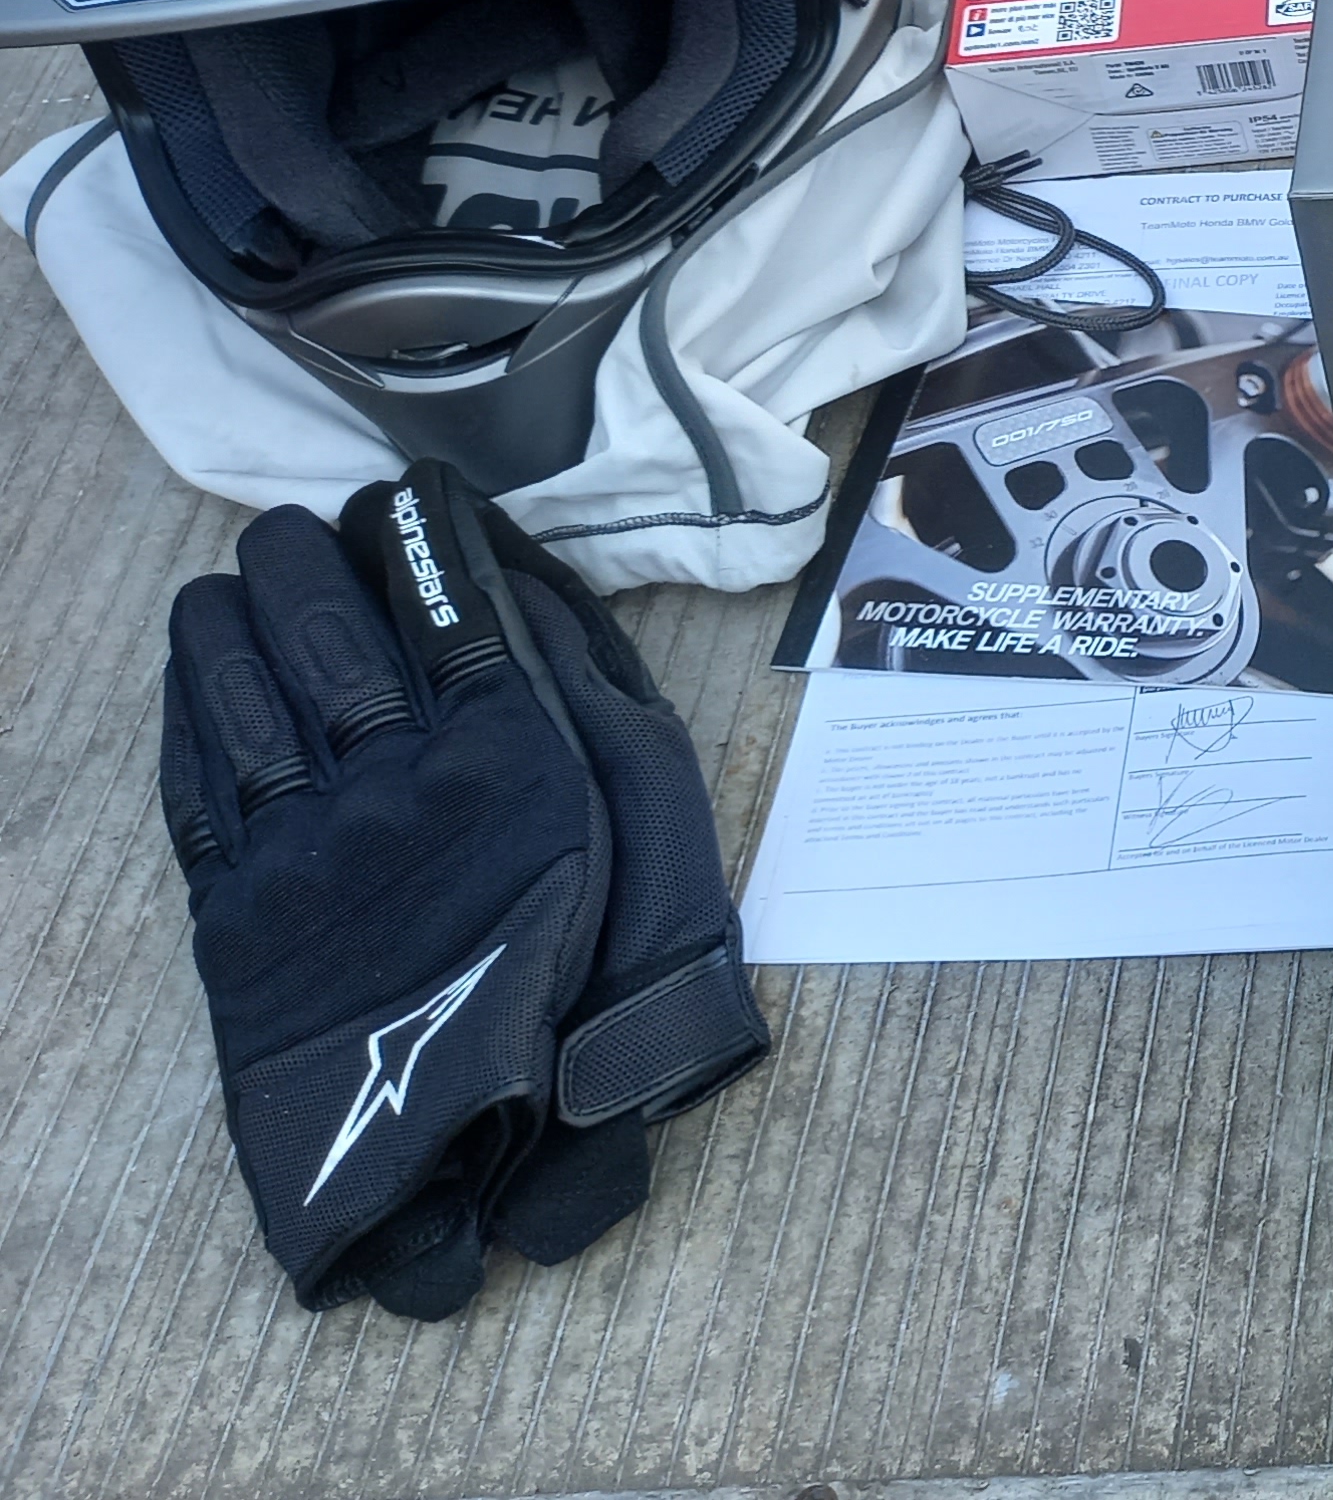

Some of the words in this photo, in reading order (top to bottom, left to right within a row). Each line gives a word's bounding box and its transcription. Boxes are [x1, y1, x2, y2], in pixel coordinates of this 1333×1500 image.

[1140, 195, 1201, 206] CONTRACT
[1204, 194, 1220, 203] TO
[1223, 193, 1283, 202] PURCHASE
[1141, 220, 1196, 230] TeamMoto
[1199, 219, 1234, 228] Honda
[1237, 218, 1267, 227] BMW
[1164, 276, 1210, 290] FINAL
[1216, 273, 1258, 286] COPY
[992, 409, 1093, 448] 001/750
[389, 487, 460, 628] alpinestars
[967, 581, 1201, 612] SUPPLEMENTARY
[856, 601, 1047, 629] MOTORCYCLE
[1052, 610, 1207, 636] WARRANTY.
[890, 628, 972, 650] MAKE
[976, 631, 1037, 653] LIFE
[1038, 634, 1063, 655] A
[1068, 635, 1140, 658] RIDE.
[947, 714, 966, 724] and
[967, 712, 998, 723] agrees
